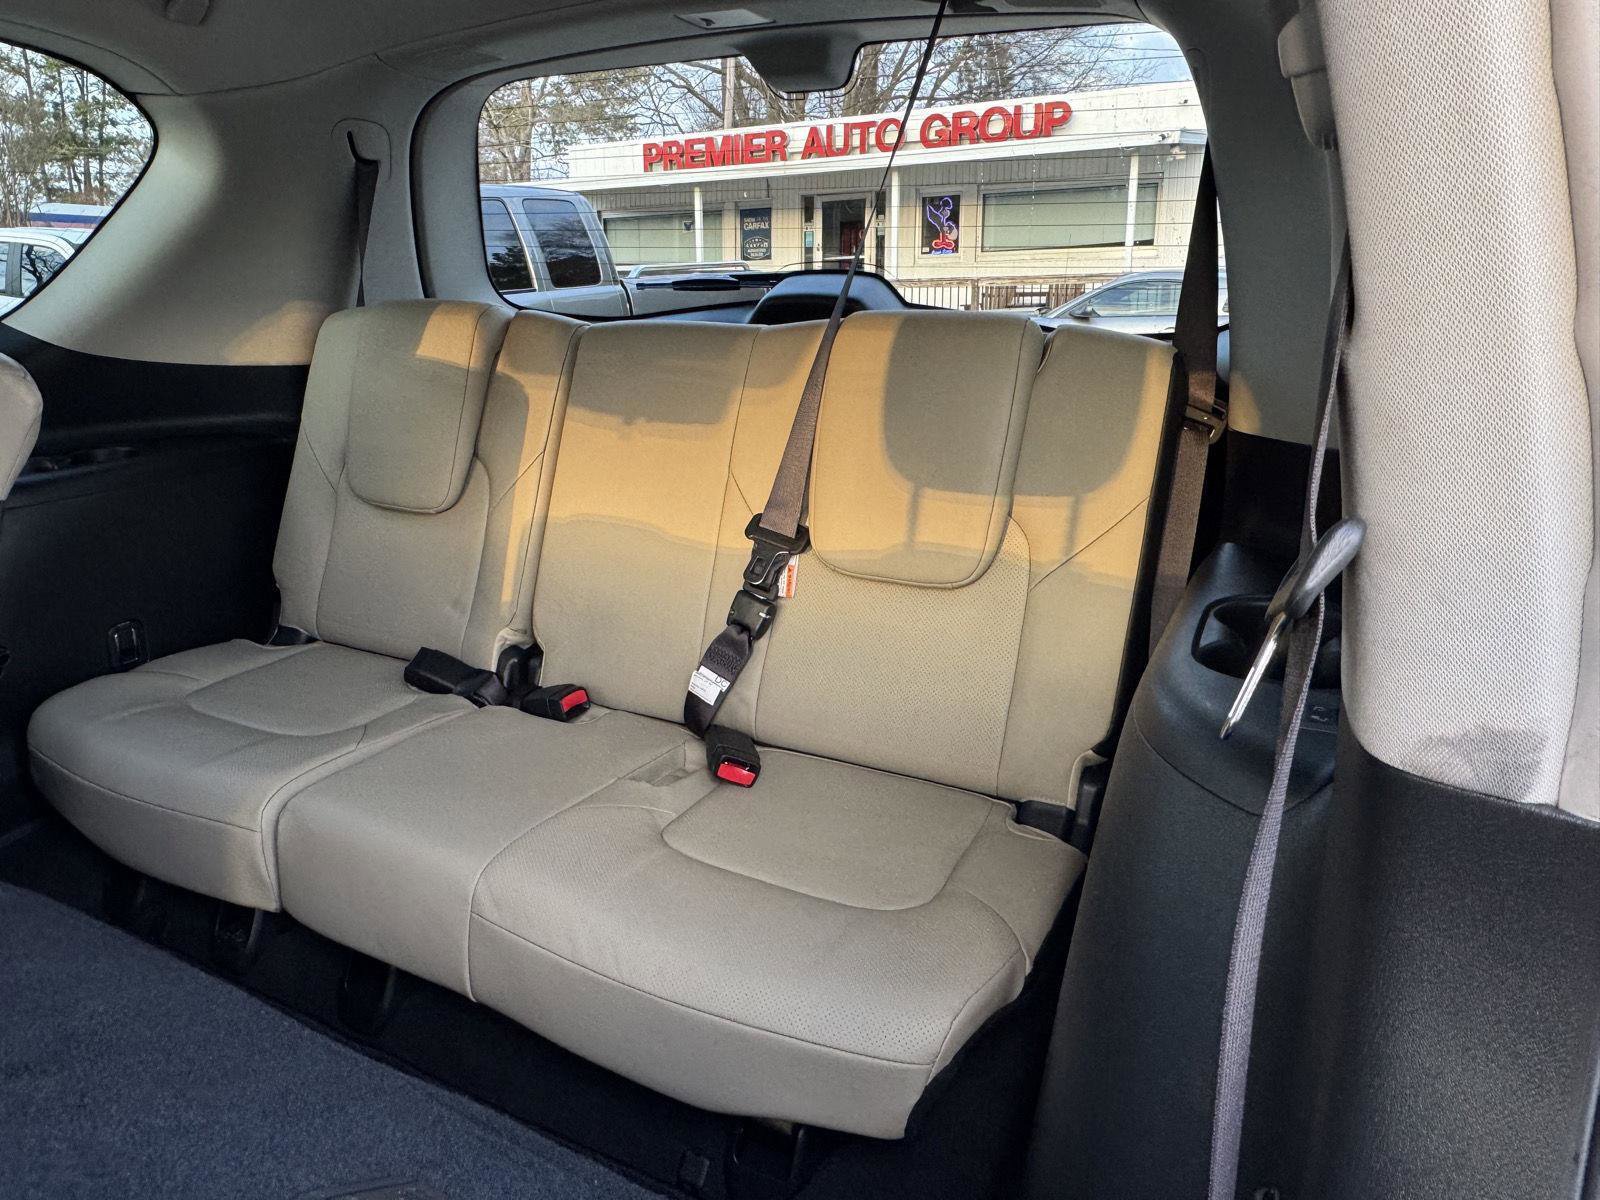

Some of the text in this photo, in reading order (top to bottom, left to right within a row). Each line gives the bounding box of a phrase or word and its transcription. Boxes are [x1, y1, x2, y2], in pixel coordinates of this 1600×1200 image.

[643, 100, 1073, 172] PREMIER AUTO GROUP
[743, 221, 770, 230] CARFAX
